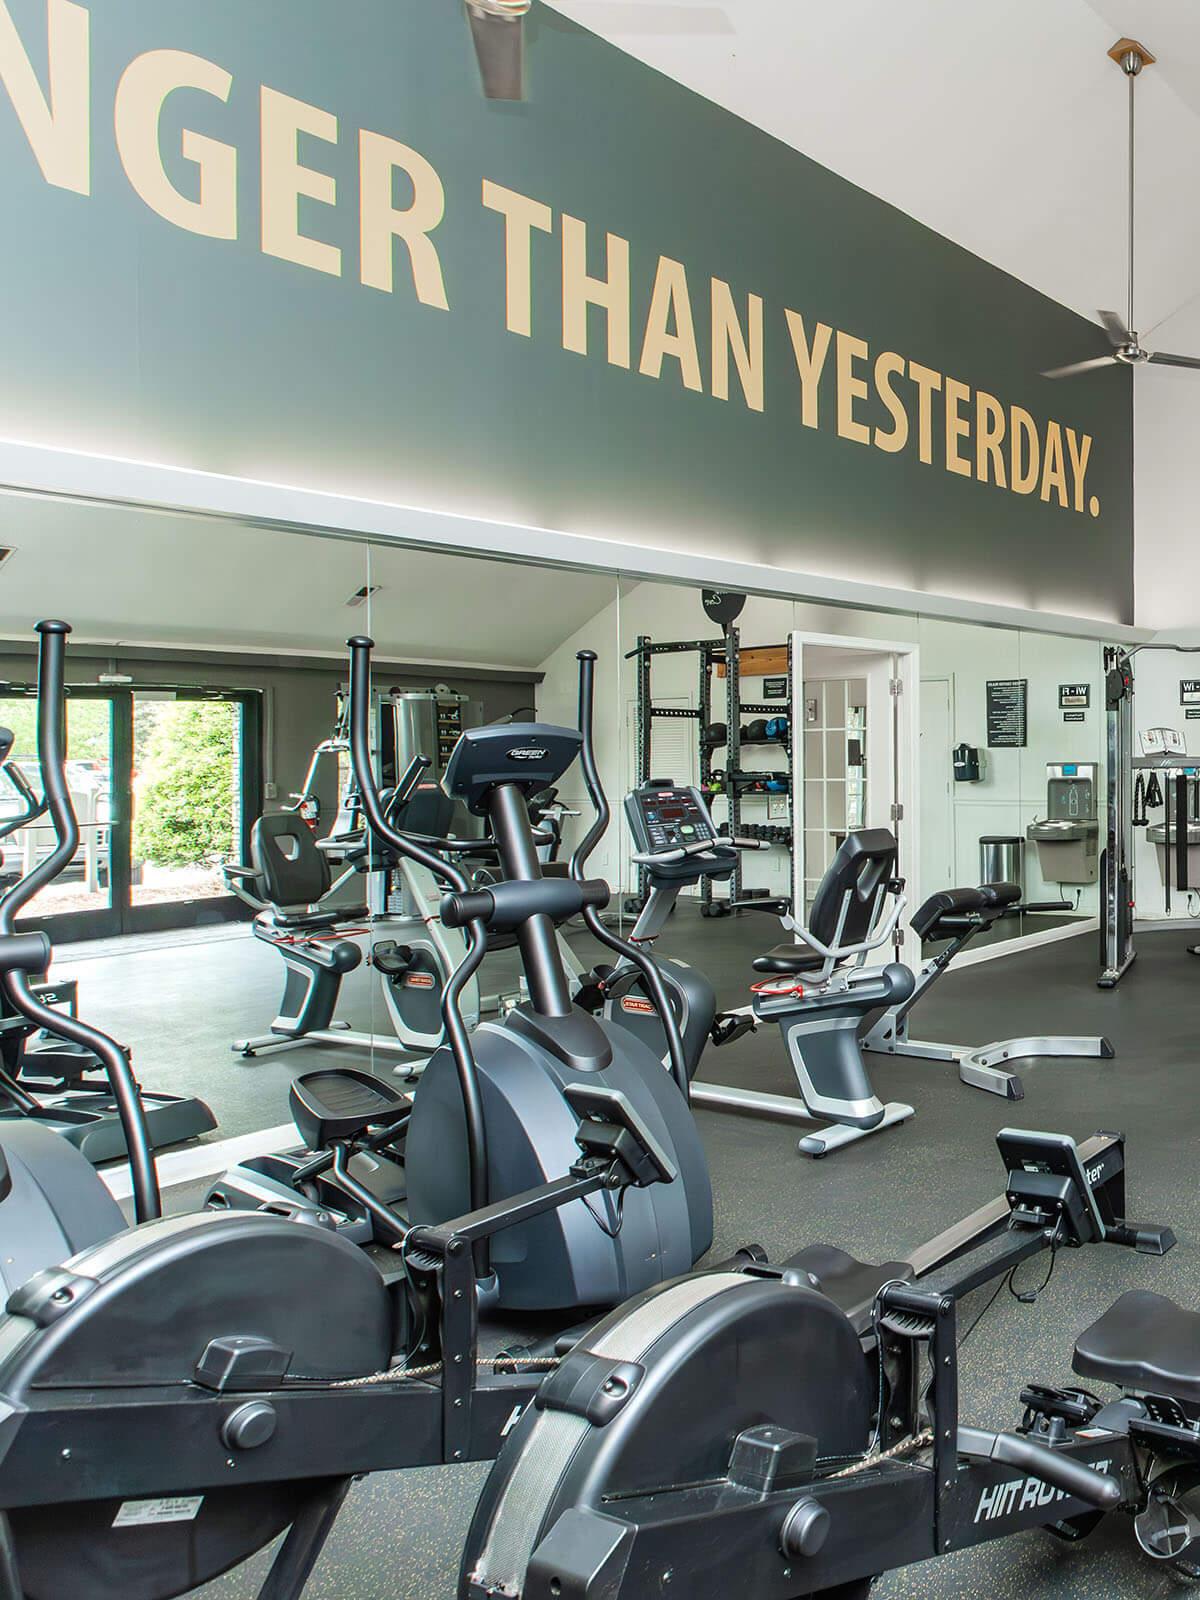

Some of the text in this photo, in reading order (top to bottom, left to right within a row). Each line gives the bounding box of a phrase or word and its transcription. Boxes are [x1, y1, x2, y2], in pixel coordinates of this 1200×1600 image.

[481, 178, 765, 413] THAN
[783, 307, 1100, 518] YESTERDAY.
[973, 1479, 1023, 1524] HIIT
